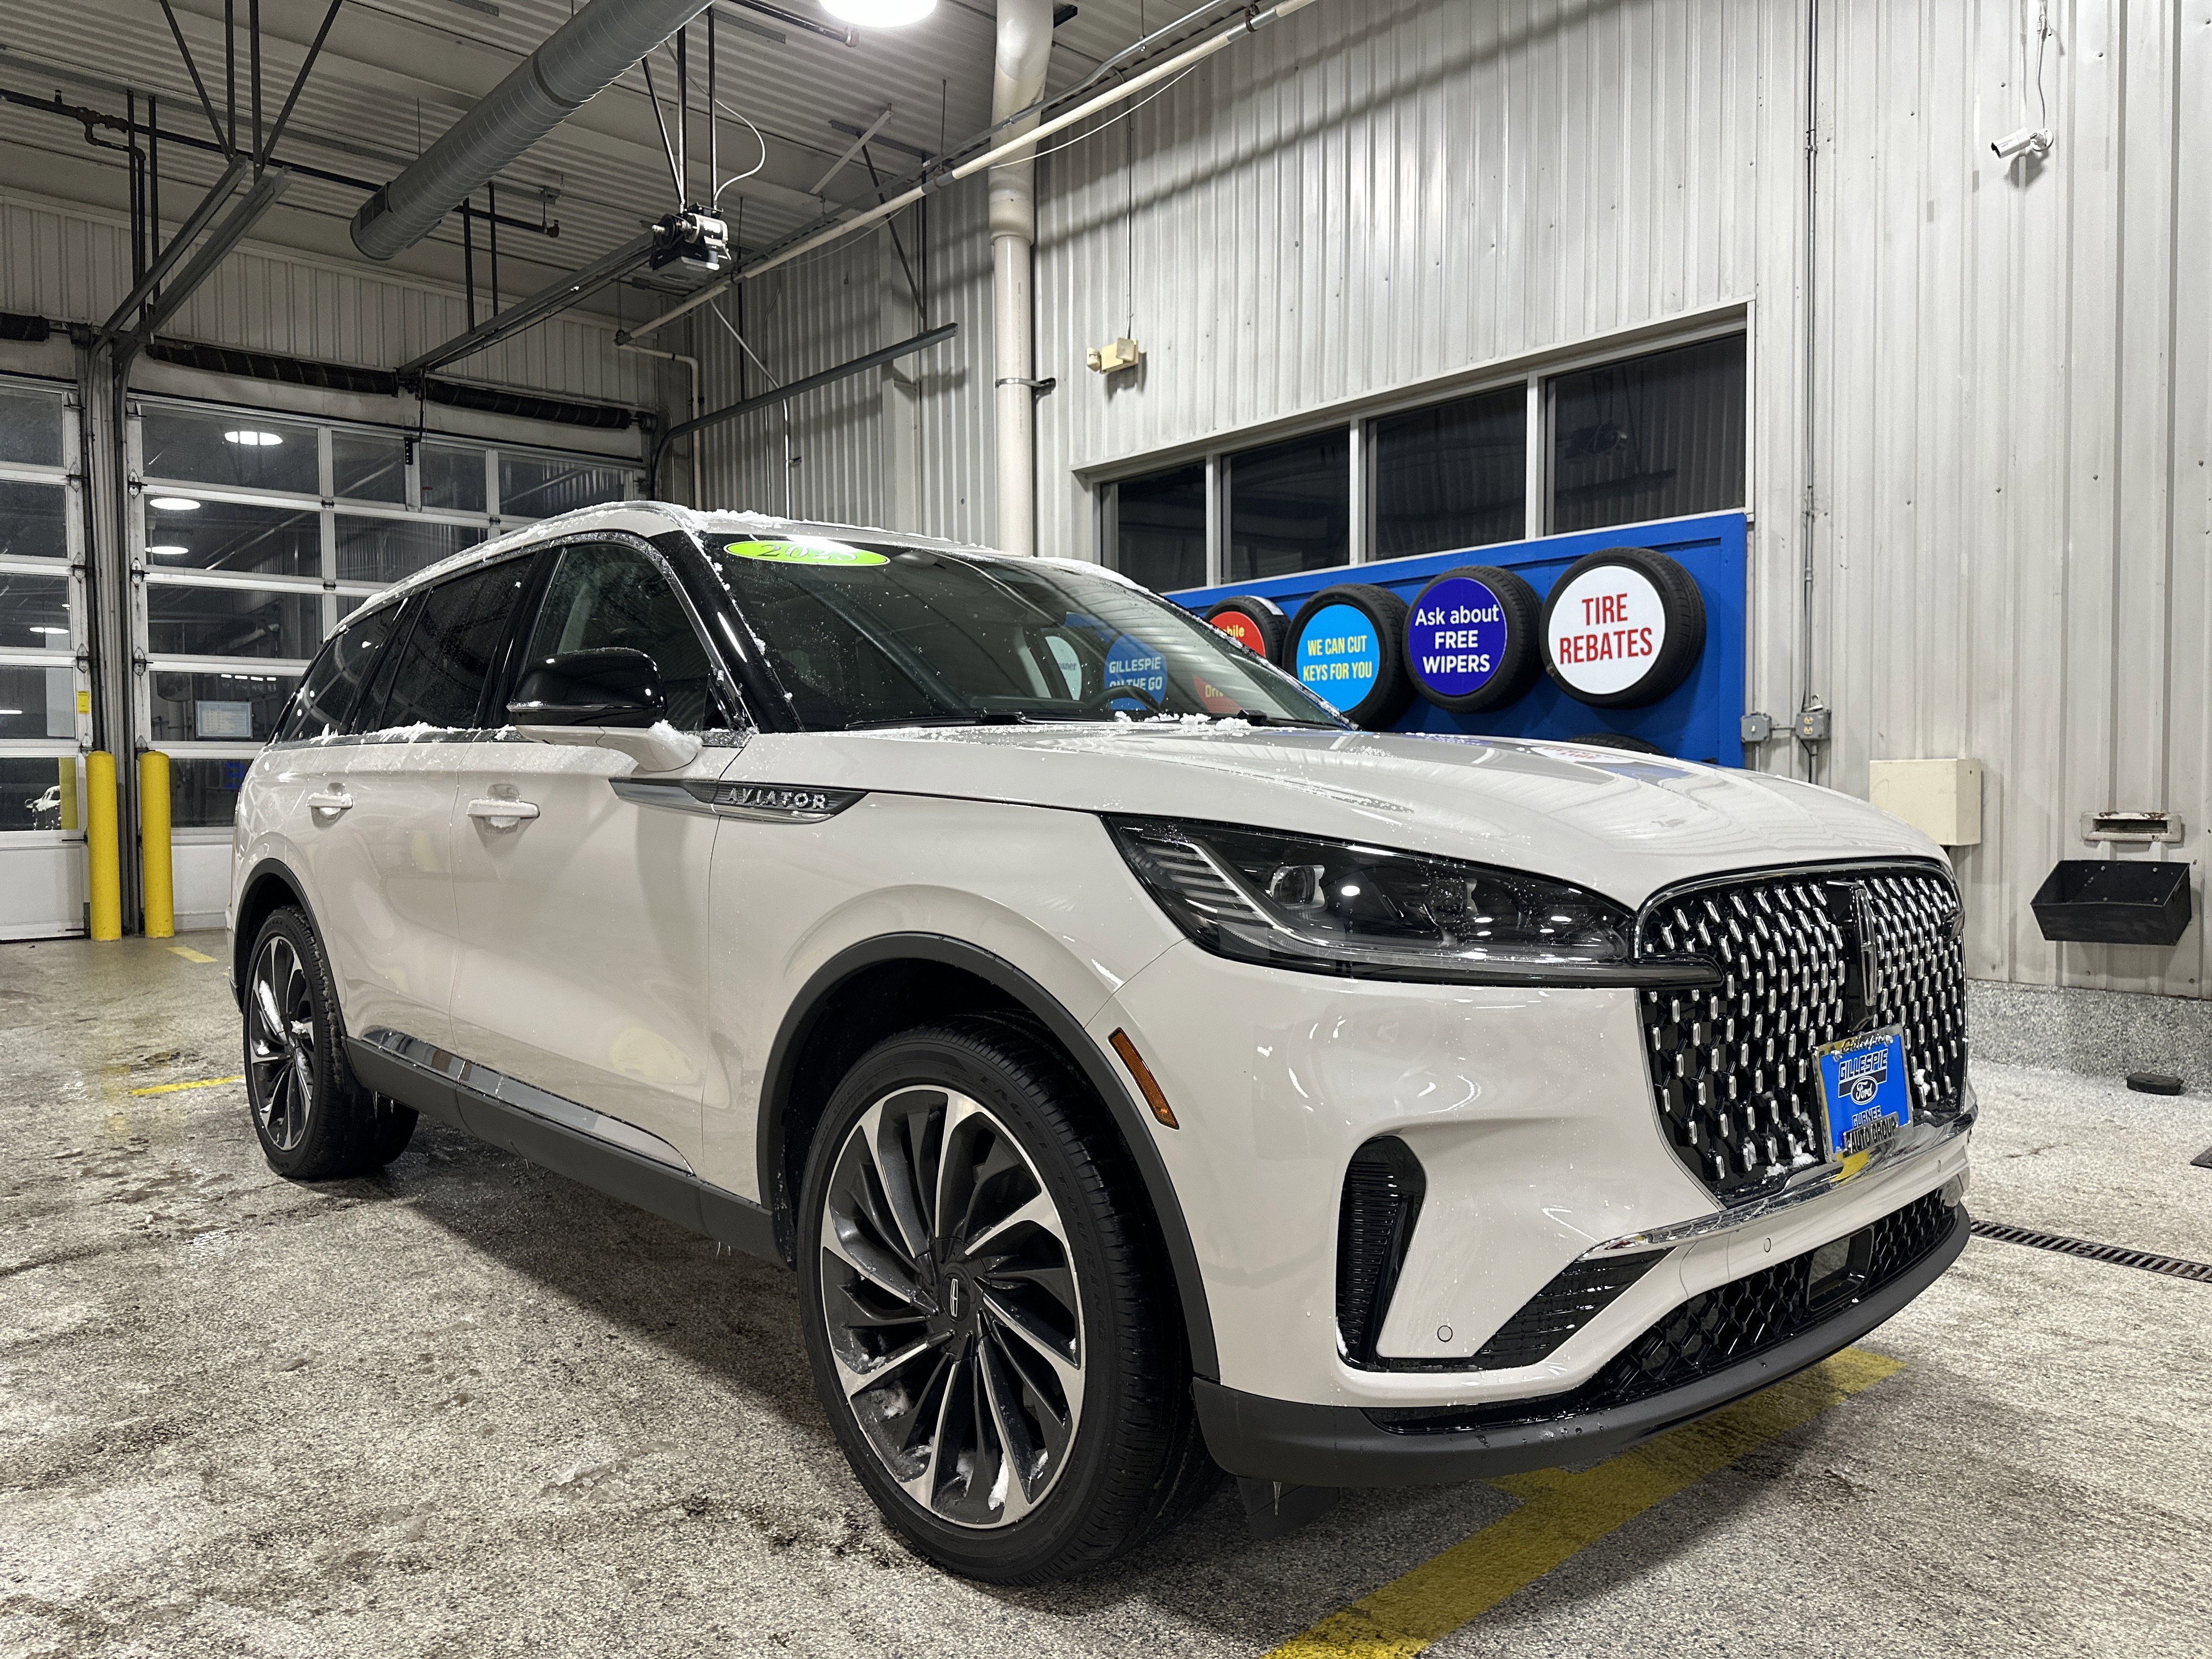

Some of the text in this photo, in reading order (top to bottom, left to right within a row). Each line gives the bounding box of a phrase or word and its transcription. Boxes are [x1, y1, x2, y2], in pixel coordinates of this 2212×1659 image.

[757, 544, 858, 561] 2025
[1415, 604, 1499, 627] Ask about
[1582, 592, 1628, 626] TIRE
[1307, 635, 1368, 656] WE CAN CUT
[1435, 629, 1479, 650] FREE
[1559, 627, 1652, 664] REBATES
[1109, 657, 1161, 674] GILLESPIE
[1303, 661, 1373, 682] KEYS FOR YOU
[1423, 654, 1491, 674] WIPERS
[1148, 676, 1163, 691] GO
[727, 787, 829, 810] AVIATOR
[1838, 1048, 1888, 1081] GILLESPIE
[1855, 1081, 1874, 1101] Ford
[1852, 1105, 1882, 1128] GURNEE
[1848, 1116, 1897, 1153] AUTO GROUP
